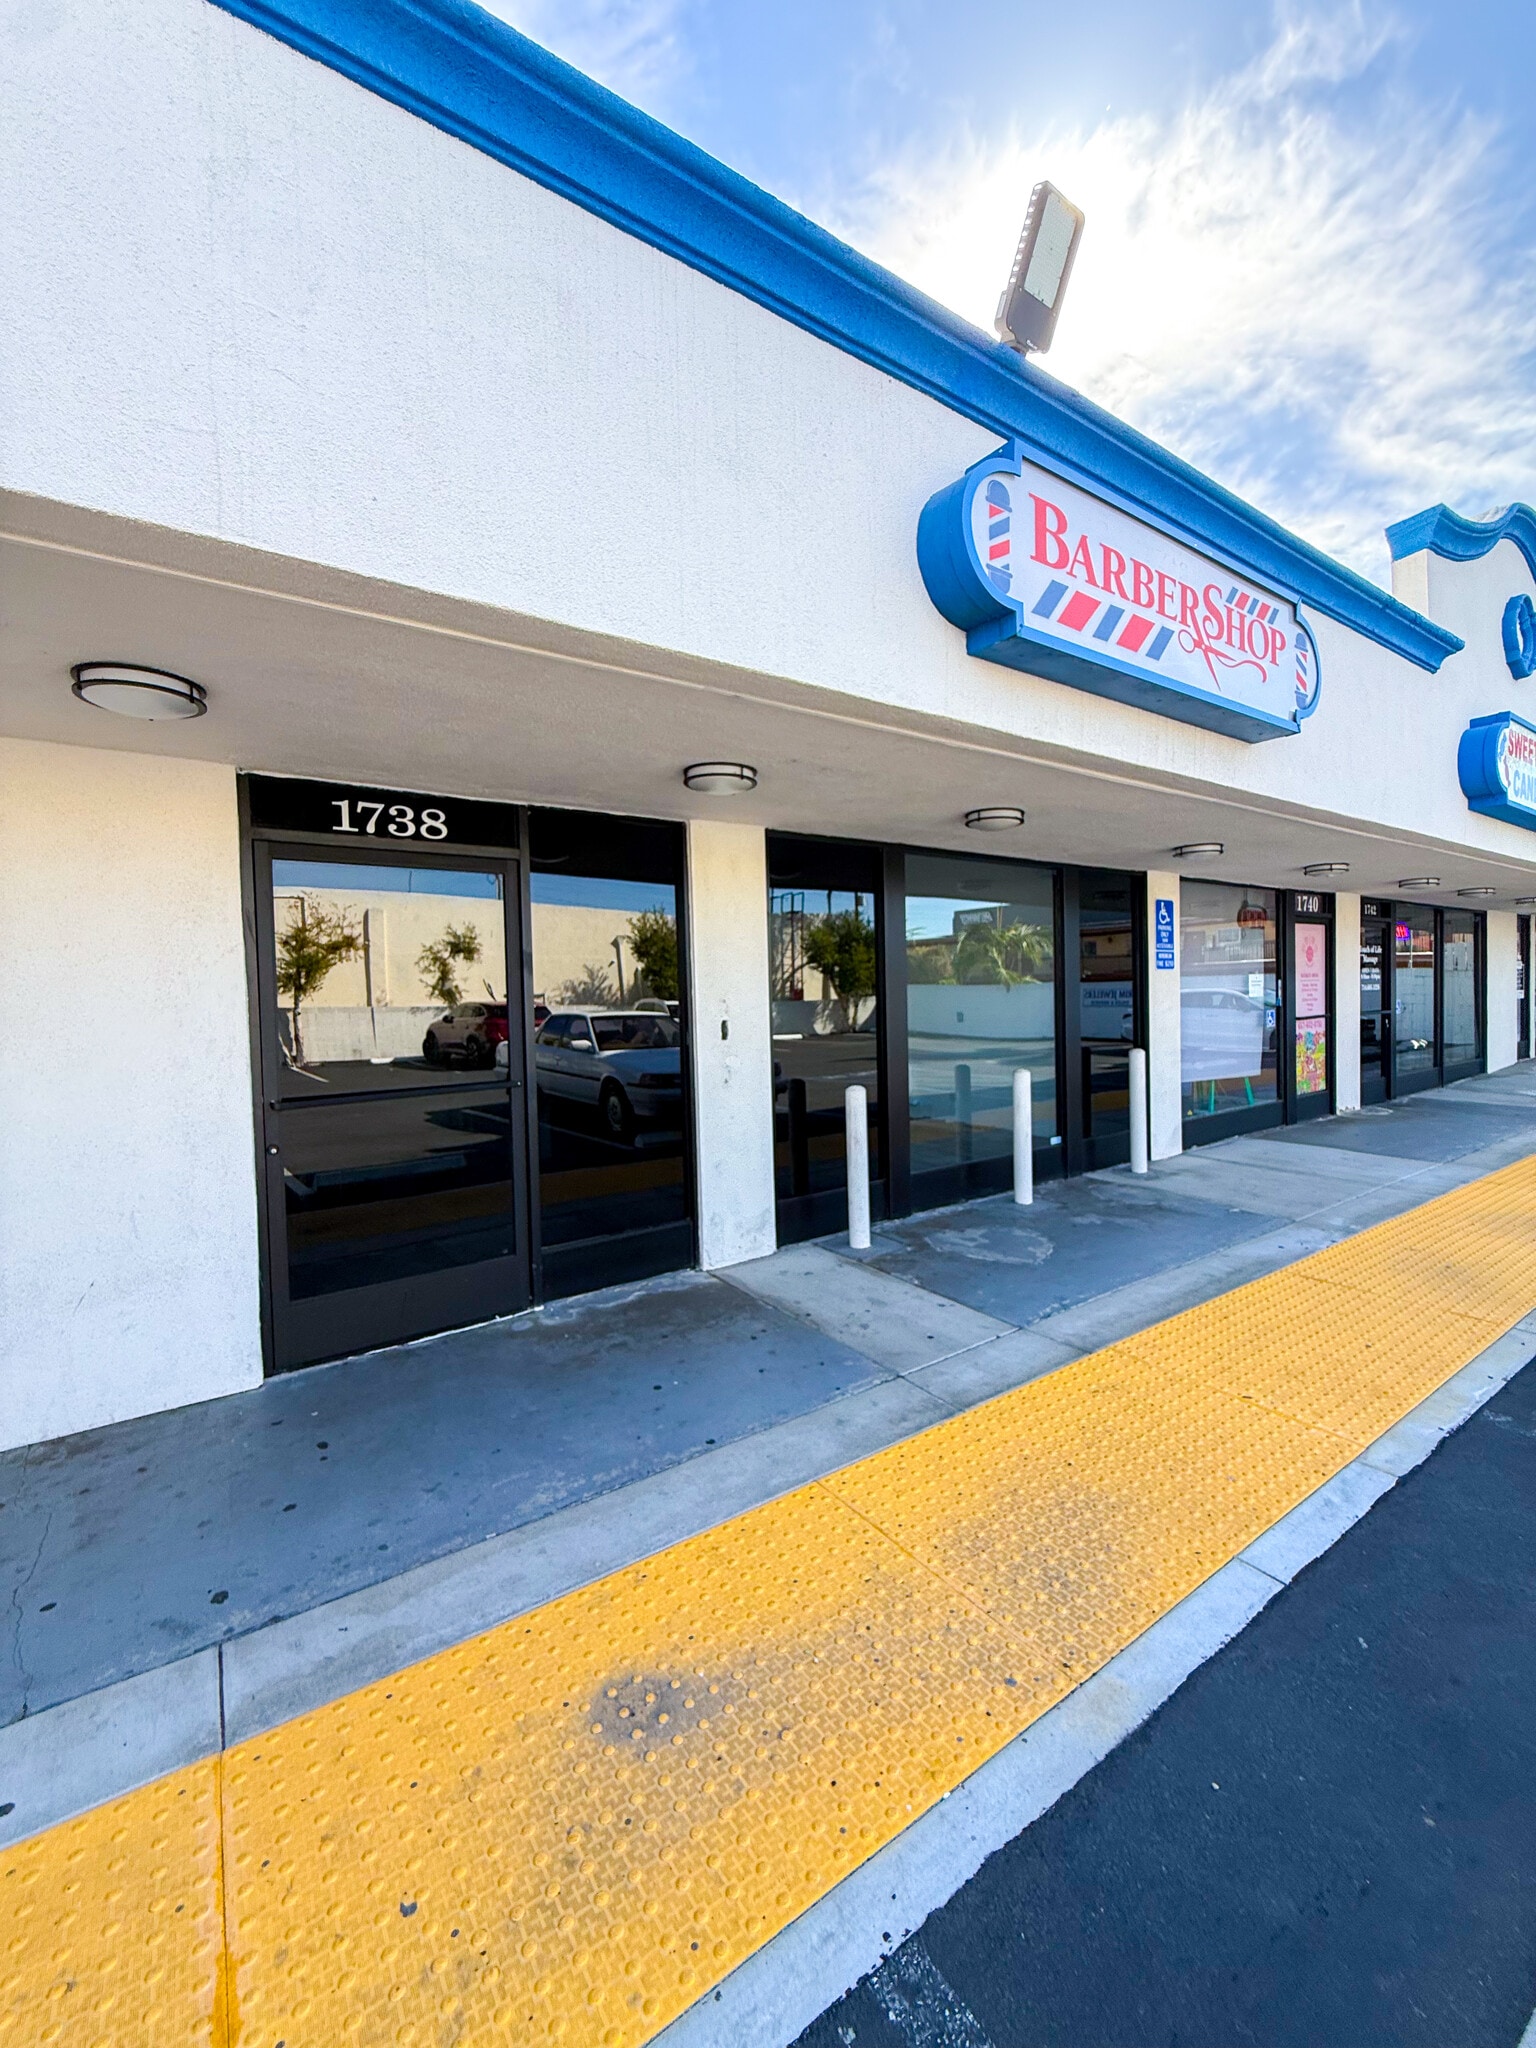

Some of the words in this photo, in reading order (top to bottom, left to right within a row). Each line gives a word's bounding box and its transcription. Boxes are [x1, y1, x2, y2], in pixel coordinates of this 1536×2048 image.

[1513, 769, 1536, 804] CAN
[331, 799, 448, 840] 1738
[1297, 895, 1319, 912] 1740
[1364, 904, 1377, 916] 1742
